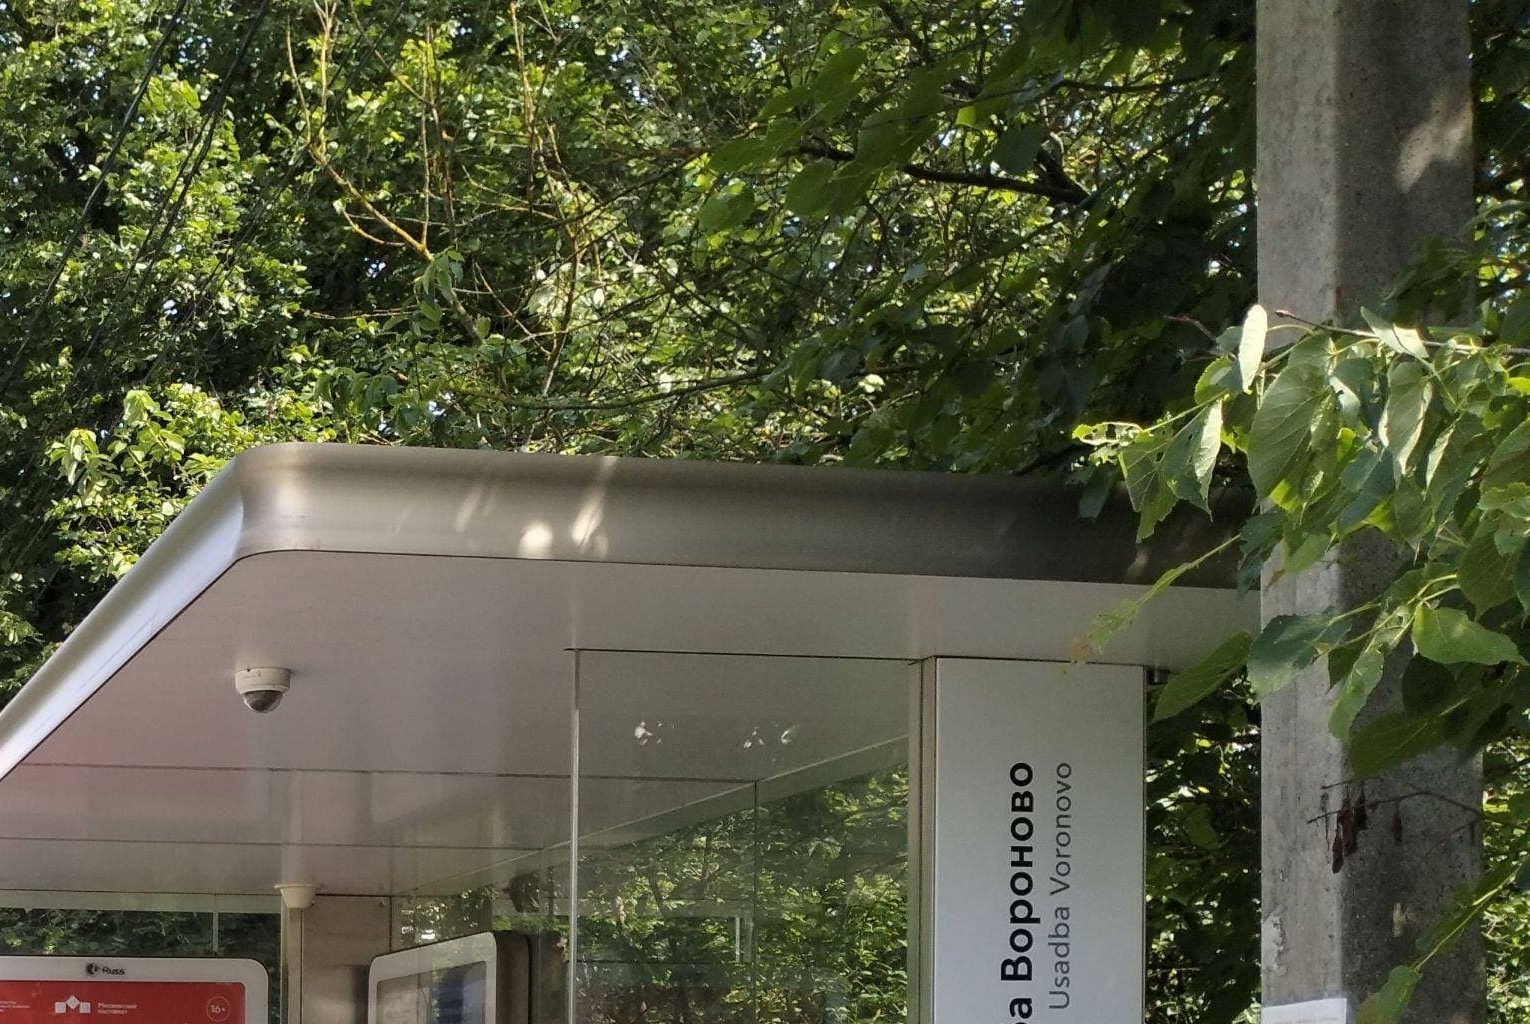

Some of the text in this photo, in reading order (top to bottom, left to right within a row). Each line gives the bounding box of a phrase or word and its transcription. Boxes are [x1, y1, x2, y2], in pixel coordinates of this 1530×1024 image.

[1000, 761, 1041, 982] Вороново
[1048, 761, 1072, 1010] Usadba Voronovo
